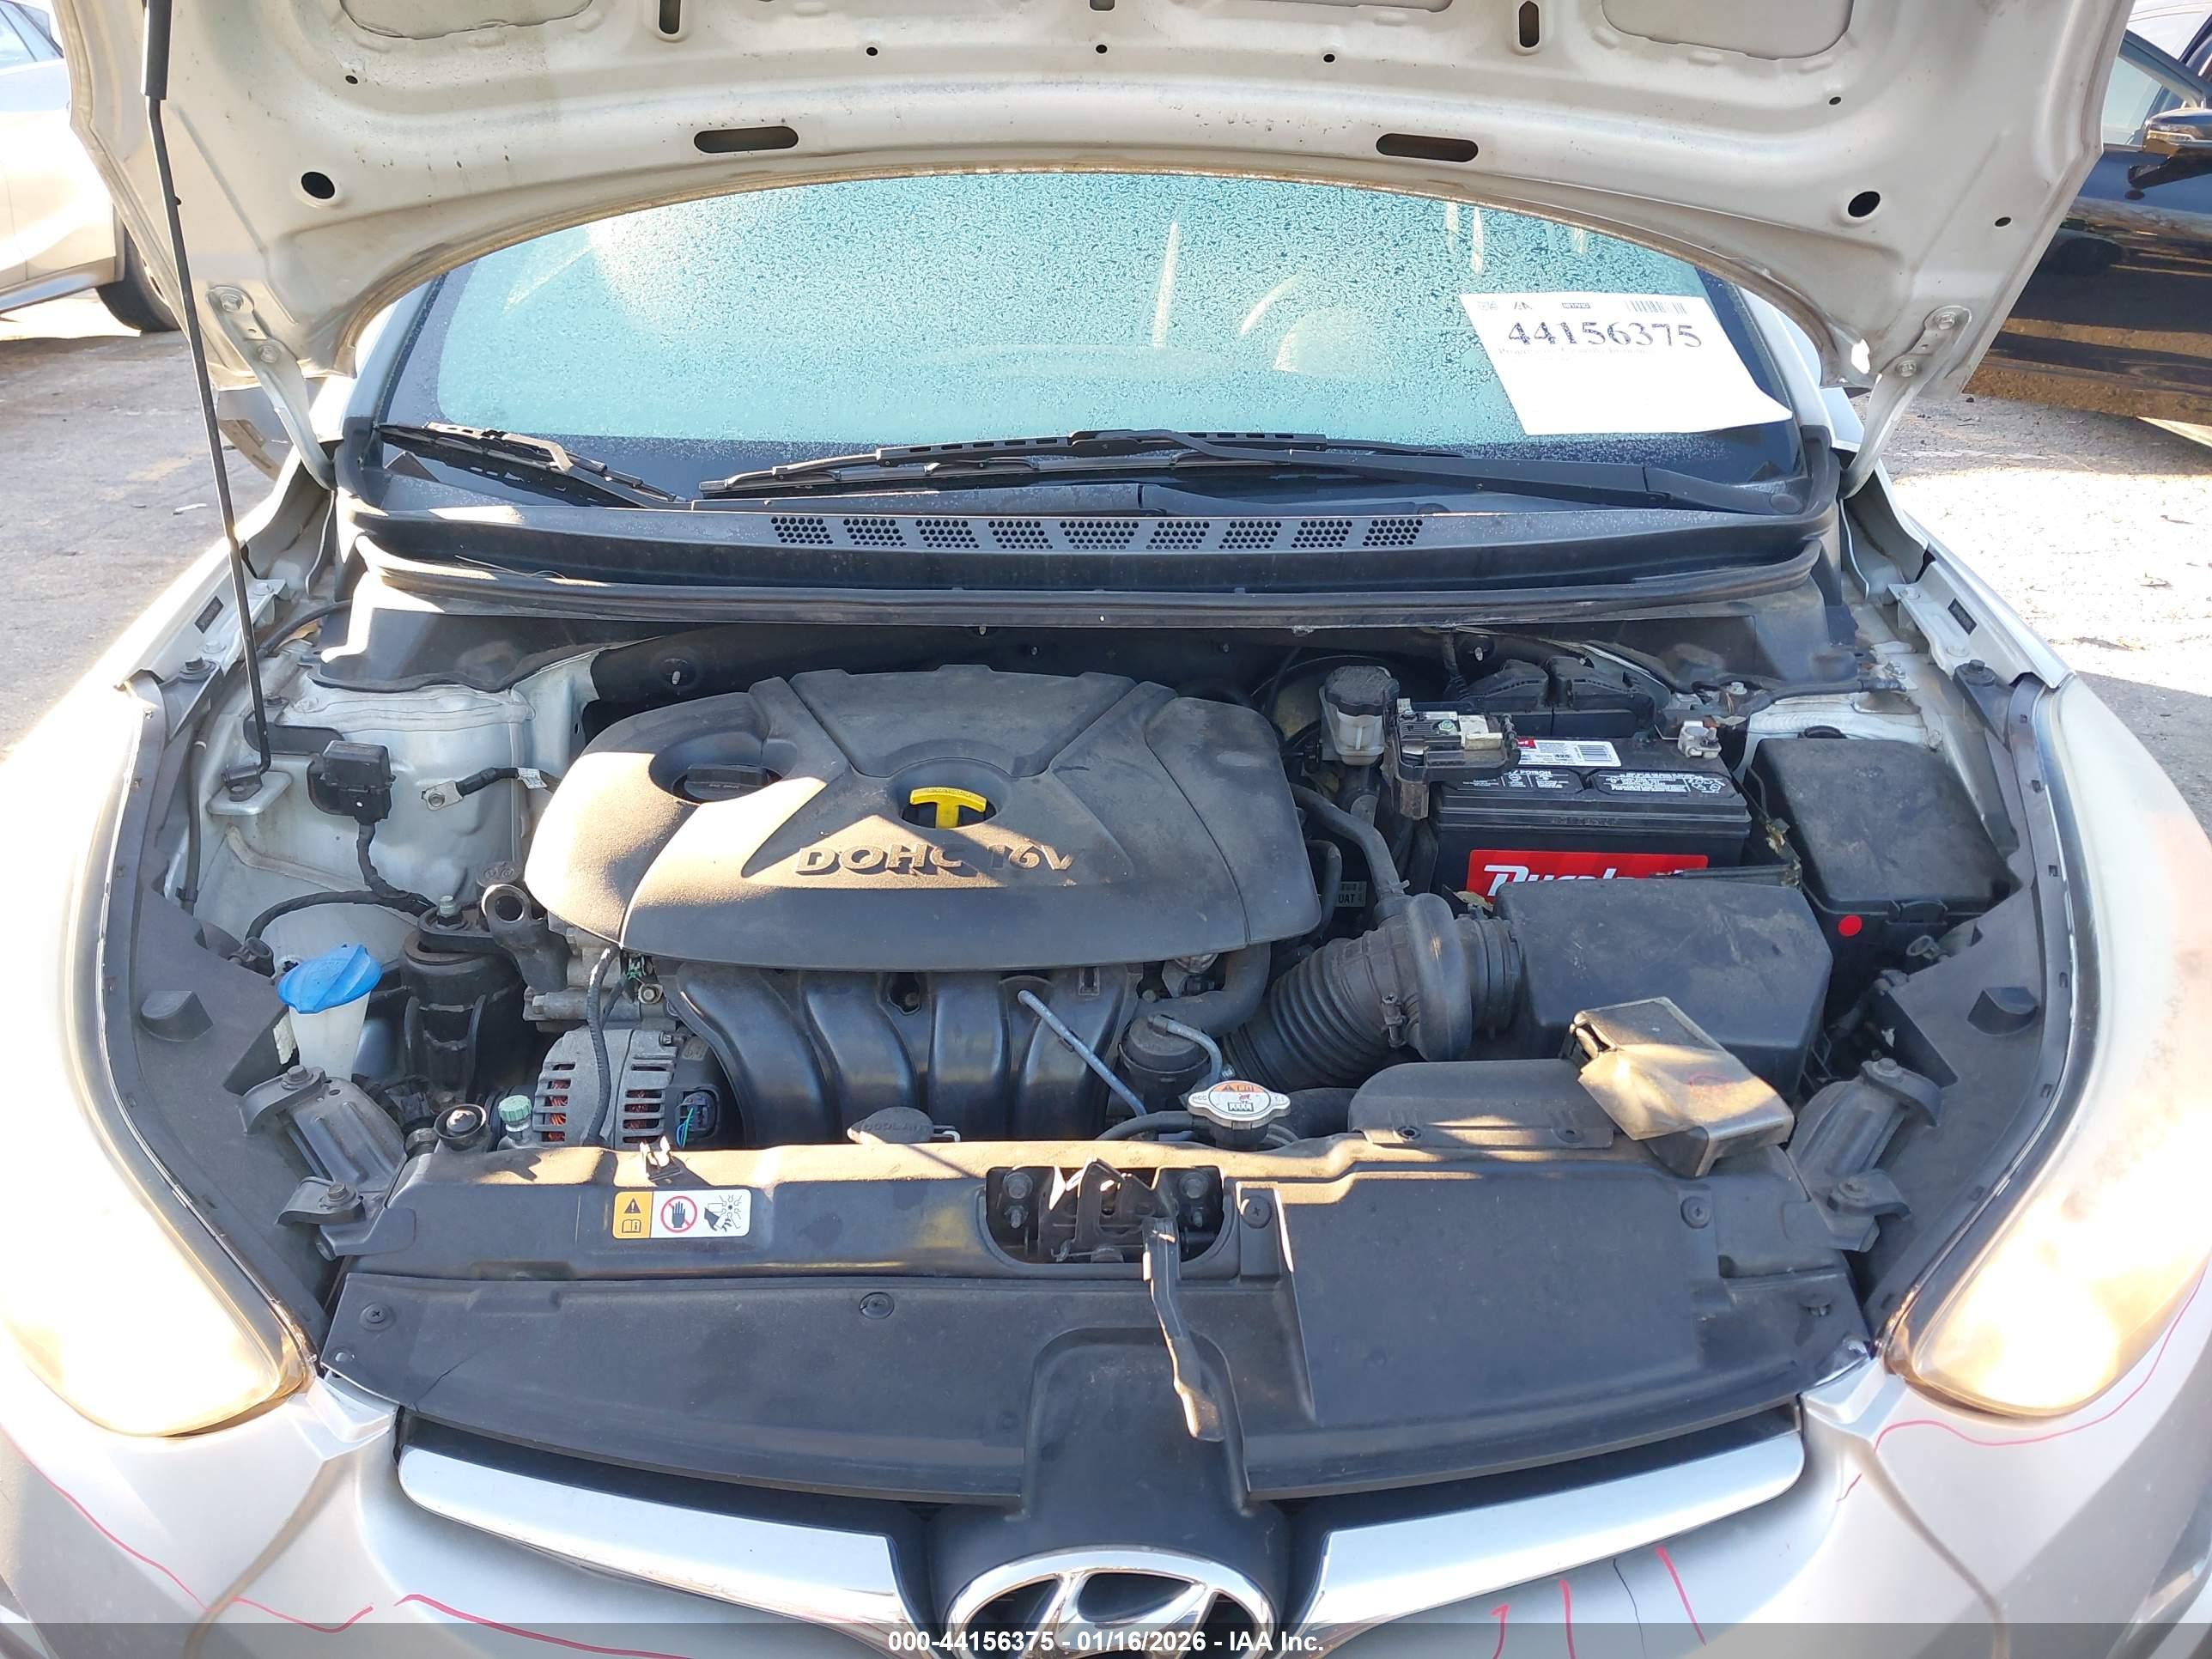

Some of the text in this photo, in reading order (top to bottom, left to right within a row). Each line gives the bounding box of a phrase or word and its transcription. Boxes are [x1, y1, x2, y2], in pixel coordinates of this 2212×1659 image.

[1508, 321, 1703, 348] 44156375
[795, 843, 1074, 873] DOHC 16V
[863, 1120, 931, 1133] COOLANT
